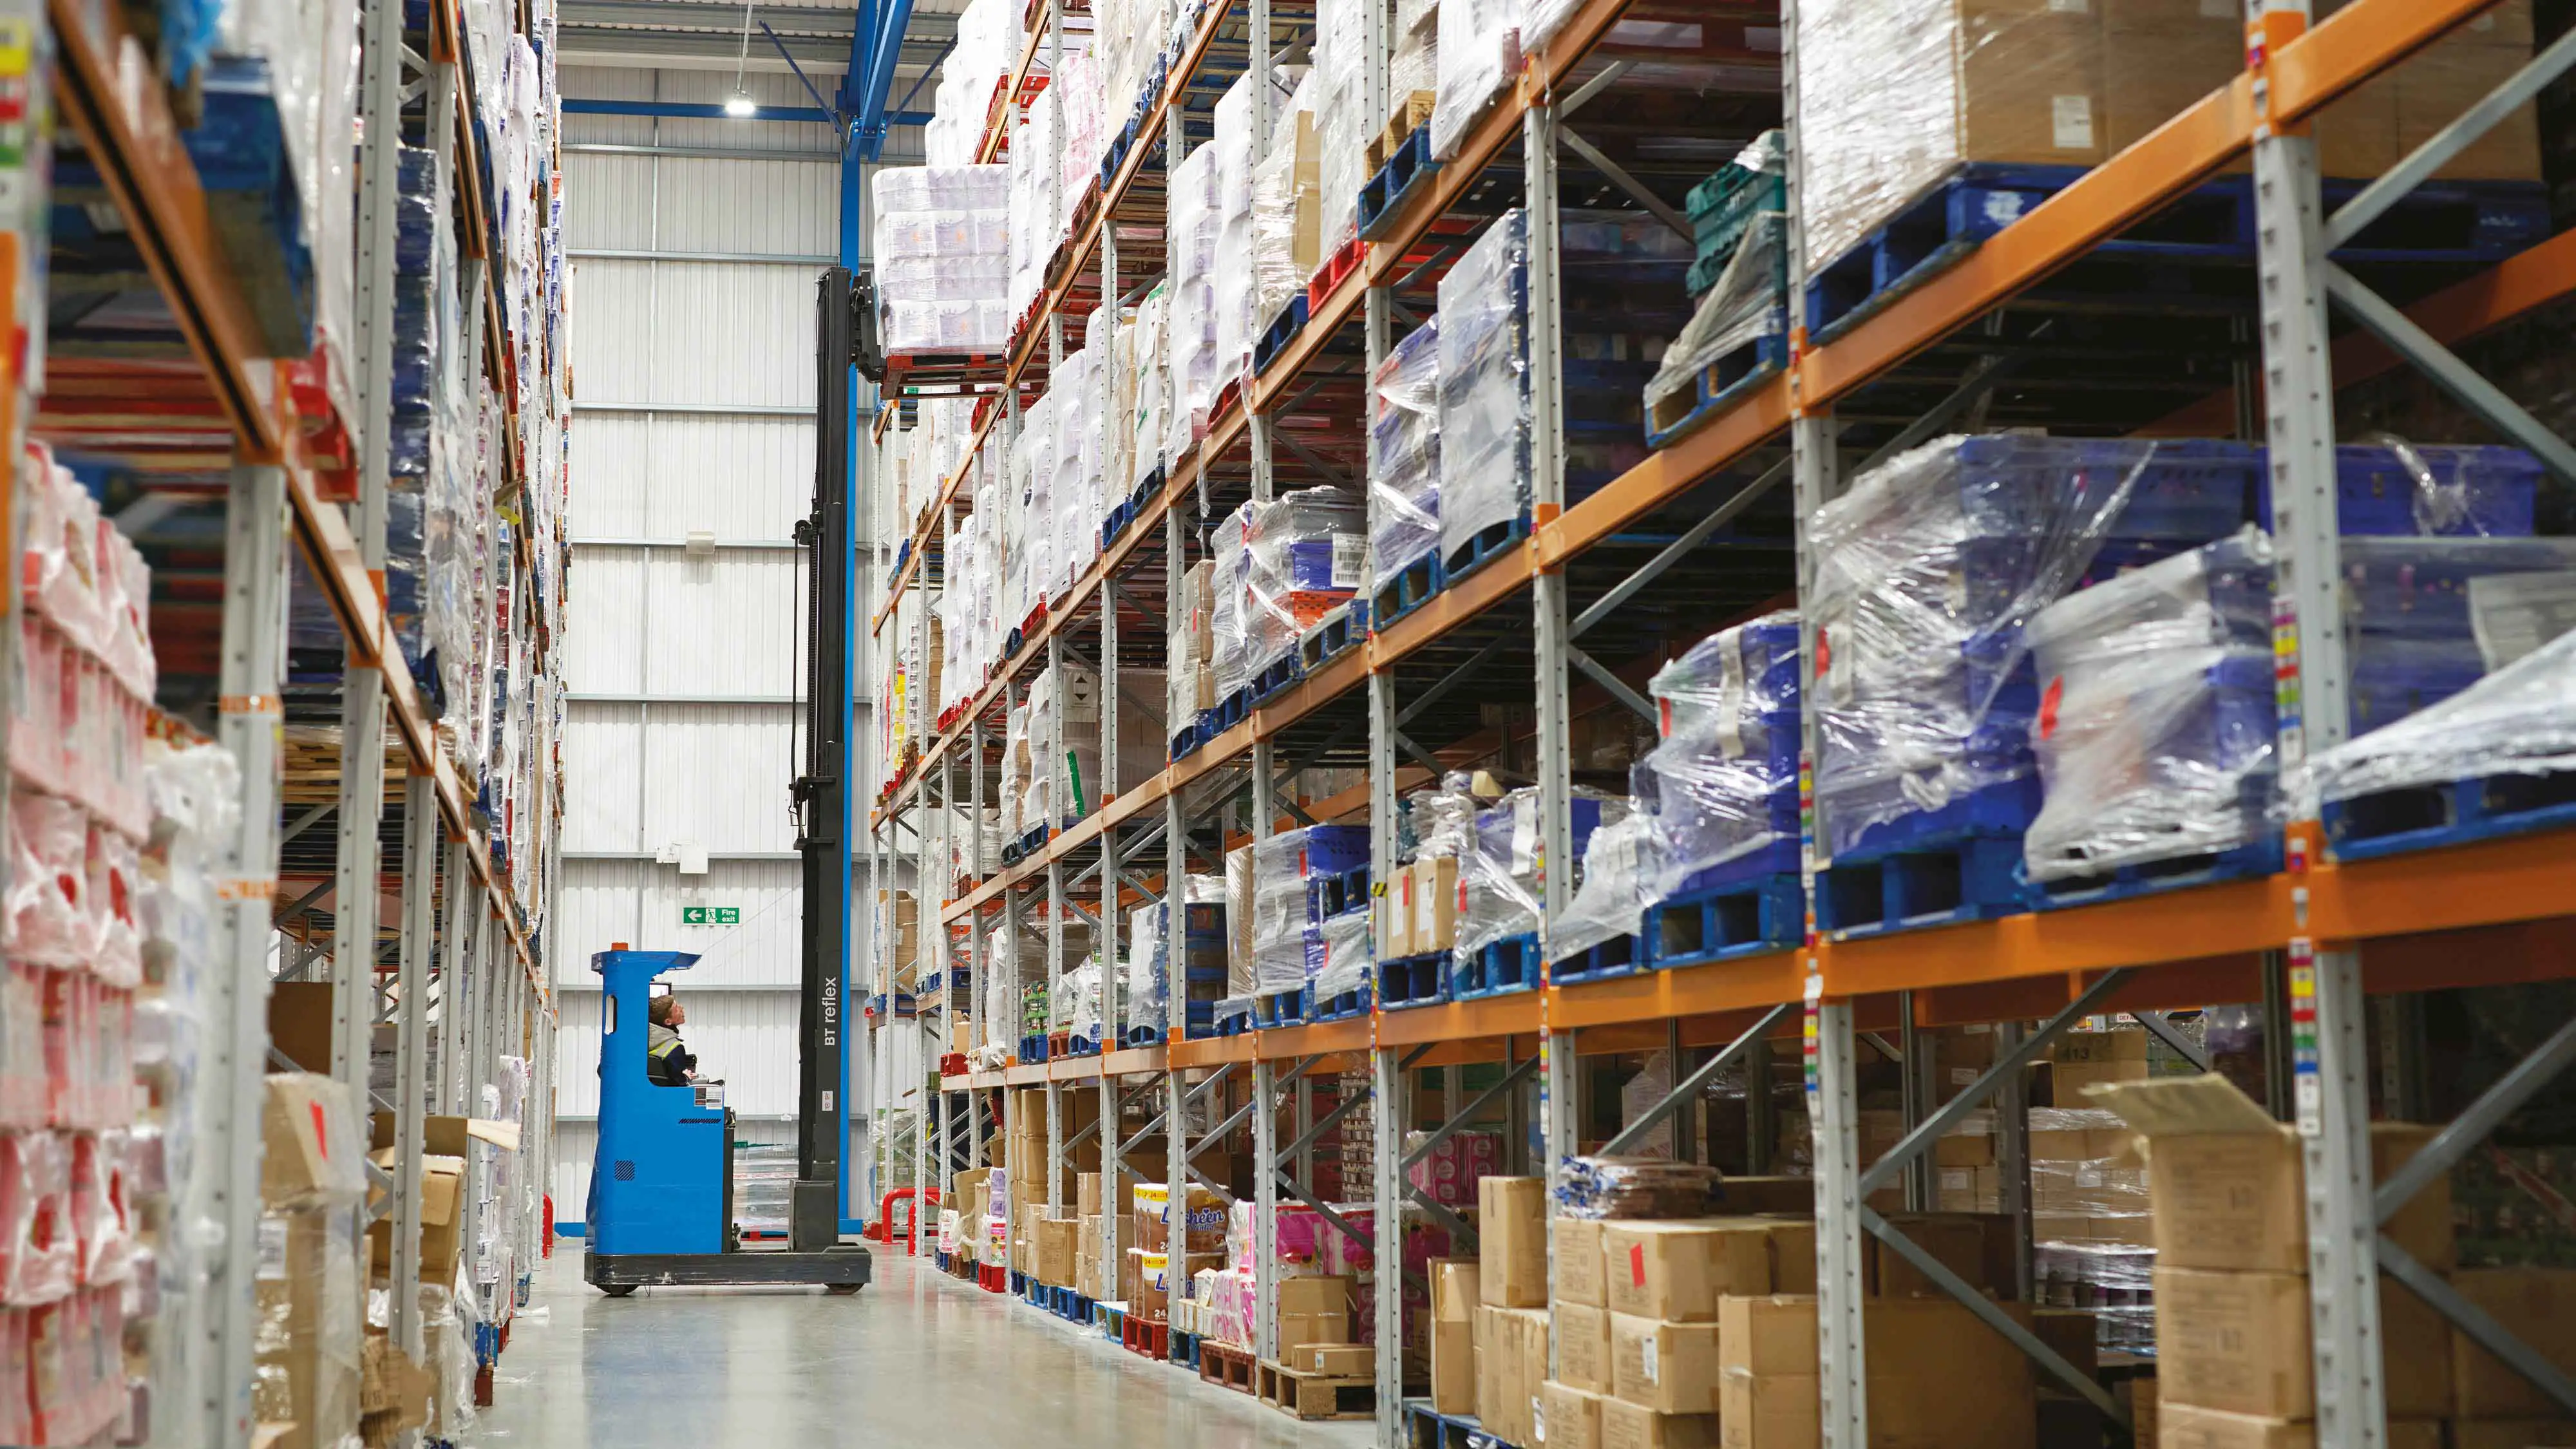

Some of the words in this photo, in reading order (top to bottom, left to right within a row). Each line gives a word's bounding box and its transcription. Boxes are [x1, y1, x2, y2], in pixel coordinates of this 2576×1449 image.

[822, 976, 837, 1023] reflex
[824, 1028, 835, 1046] BT
[1155, 1309, 1166, 1318] 24
